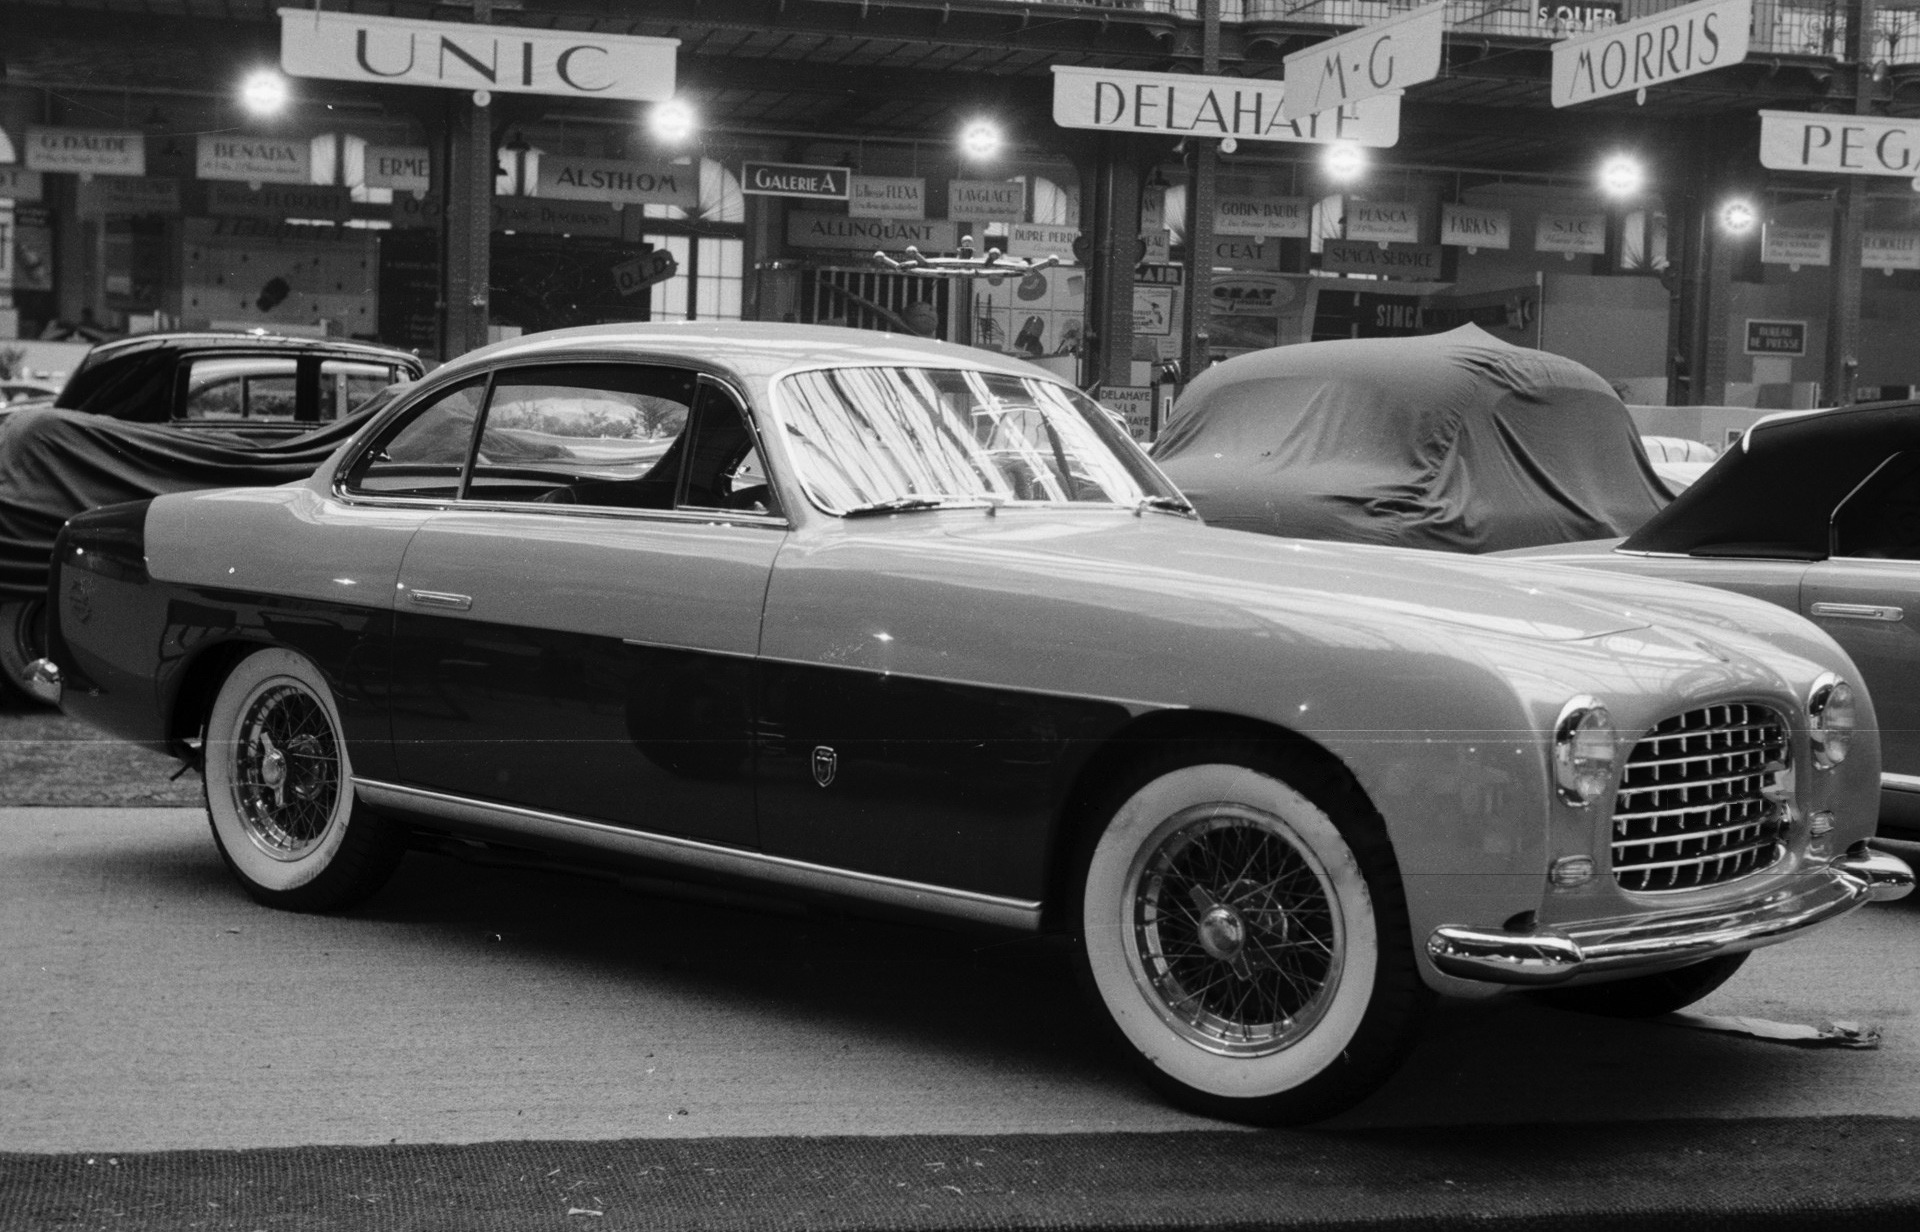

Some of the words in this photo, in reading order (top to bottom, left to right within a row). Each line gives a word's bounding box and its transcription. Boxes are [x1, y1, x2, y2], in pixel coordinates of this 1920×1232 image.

[356, 29, 618, 92] UNIC
[1569, 12, 1718, 99] MORRIS
[1802, 124, 1920, 172] PEG
[557, 166, 677, 193] ALSTHOM
[755, 168, 818, 191] GALERIE
[820, 173, 836, 192] A
[811, 219, 933, 241] ALLINQUANT
[1216, 243, 1264, 259] CEAT
[1101, 390, 1151, 401] DELAHAYE
